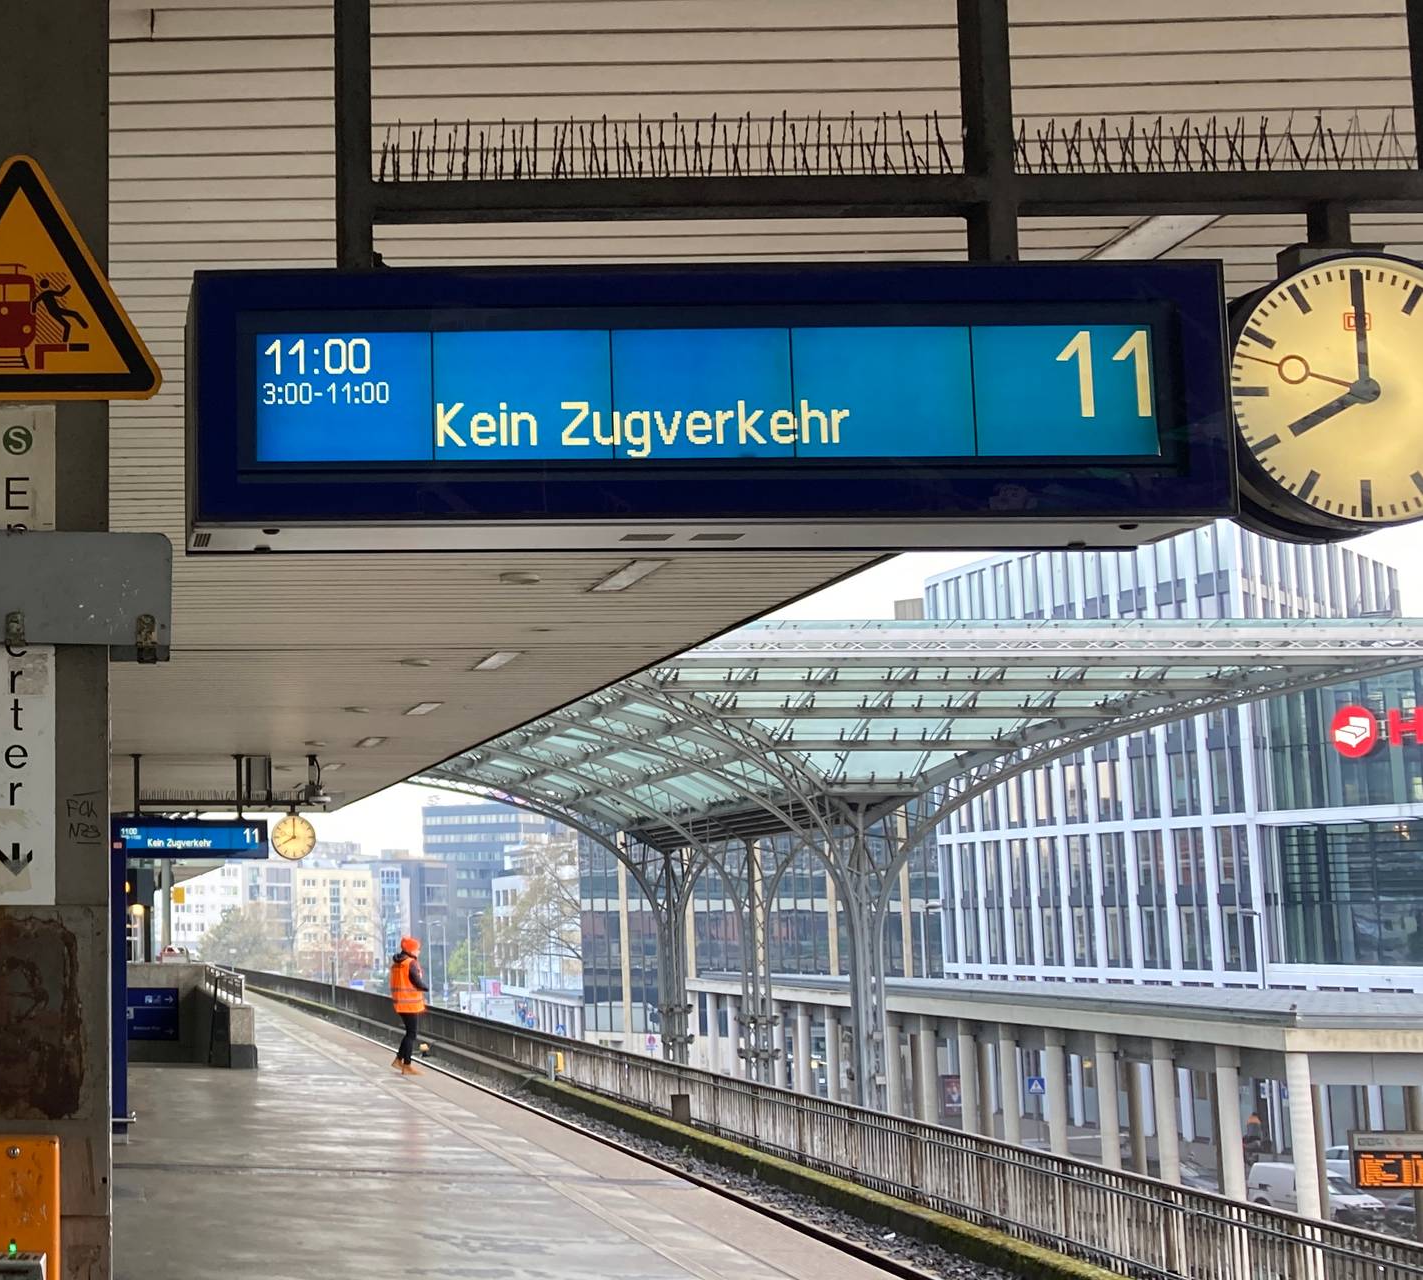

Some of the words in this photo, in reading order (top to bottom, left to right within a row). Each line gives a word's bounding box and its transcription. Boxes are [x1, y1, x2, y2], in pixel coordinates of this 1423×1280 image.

[264, 338, 371, 375] 11:00
[1056, 330, 1153, 418] 11
[262, 381, 389, 405] 3:00-11:00
[6, 428, 30, 455] S
[436, 402, 538, 447] Kein
[560, 399, 850, 458] Zugverkehr
[147, 838, 165, 848] Kein
[166, 838, 213, 850] Zugverkehr
[243, 827, 260, 844] 11
